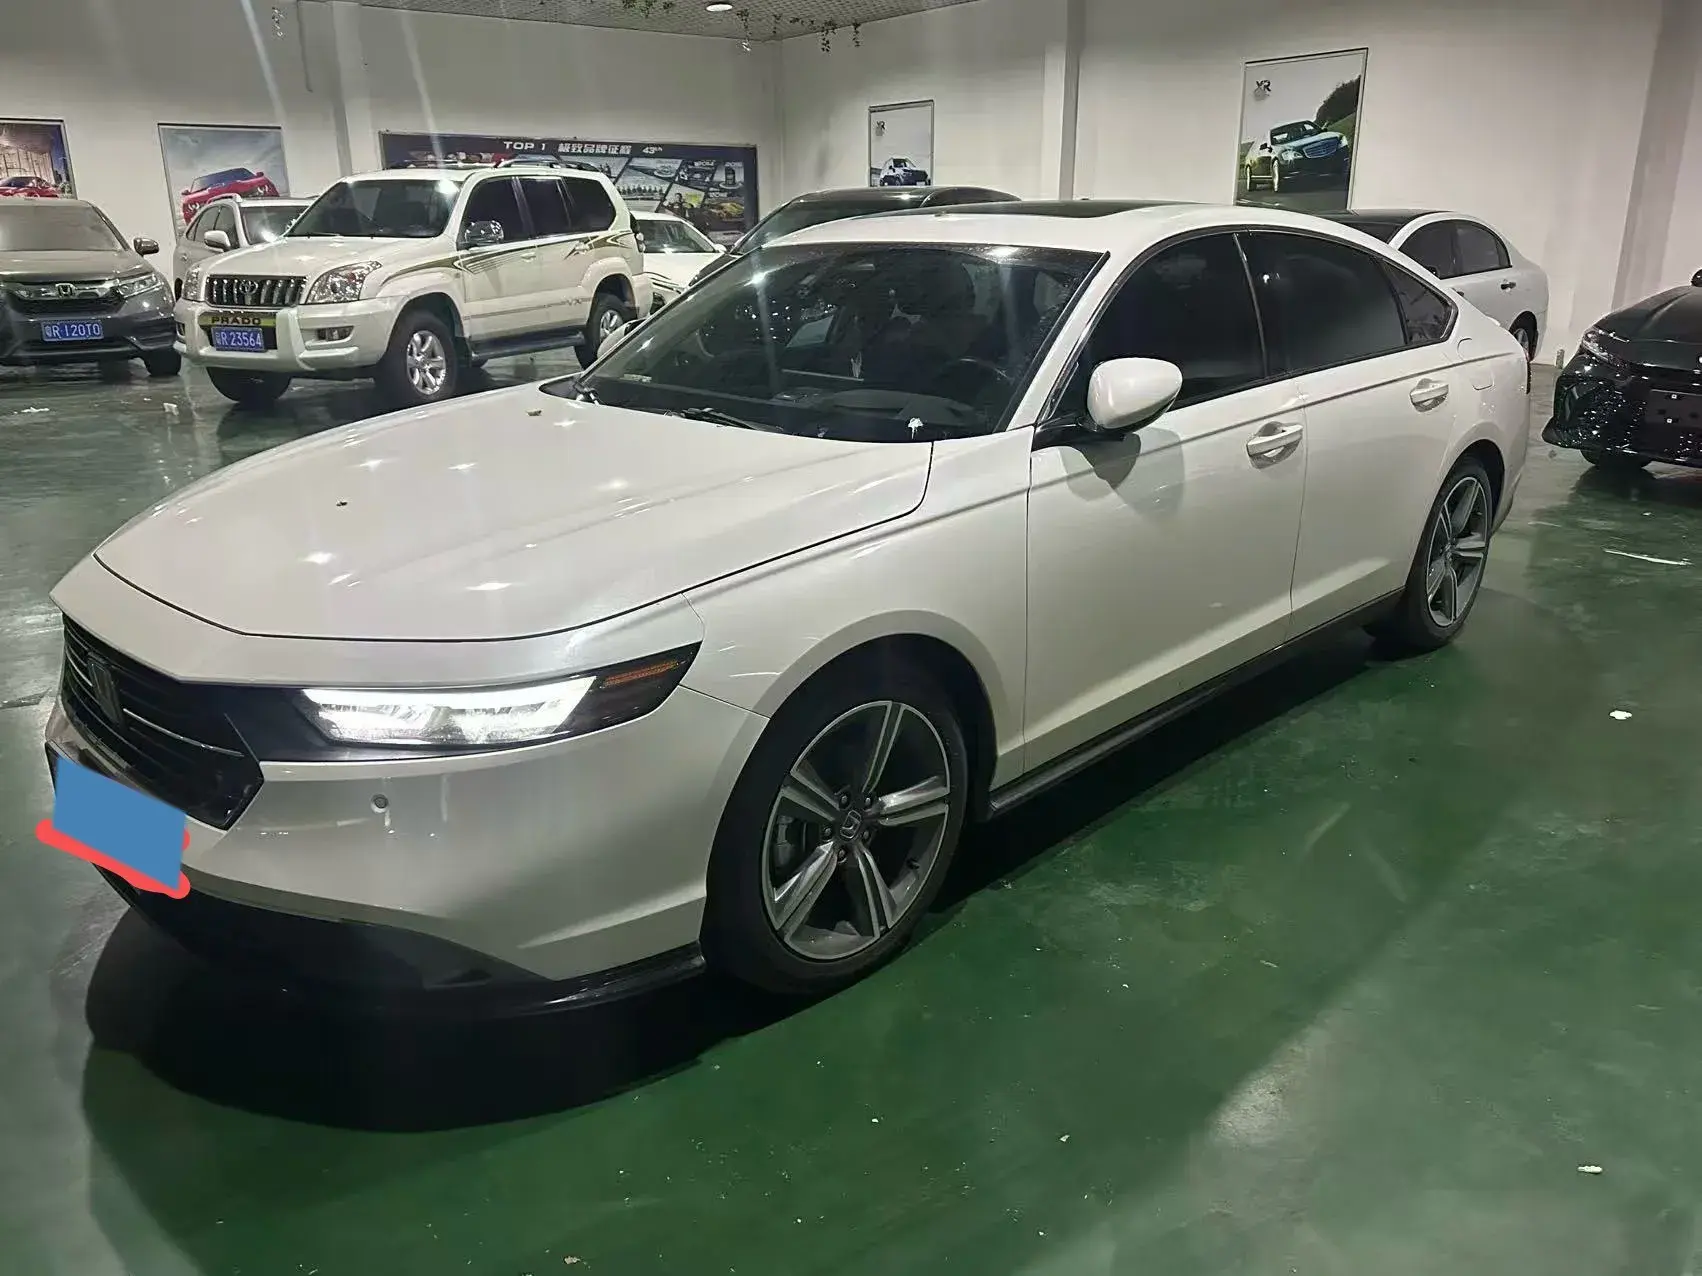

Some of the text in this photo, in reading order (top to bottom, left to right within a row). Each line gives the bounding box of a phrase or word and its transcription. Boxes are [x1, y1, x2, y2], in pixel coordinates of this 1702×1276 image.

[503, 141, 546, 151] TOP 1
[211, 316, 262, 325] PRADO
